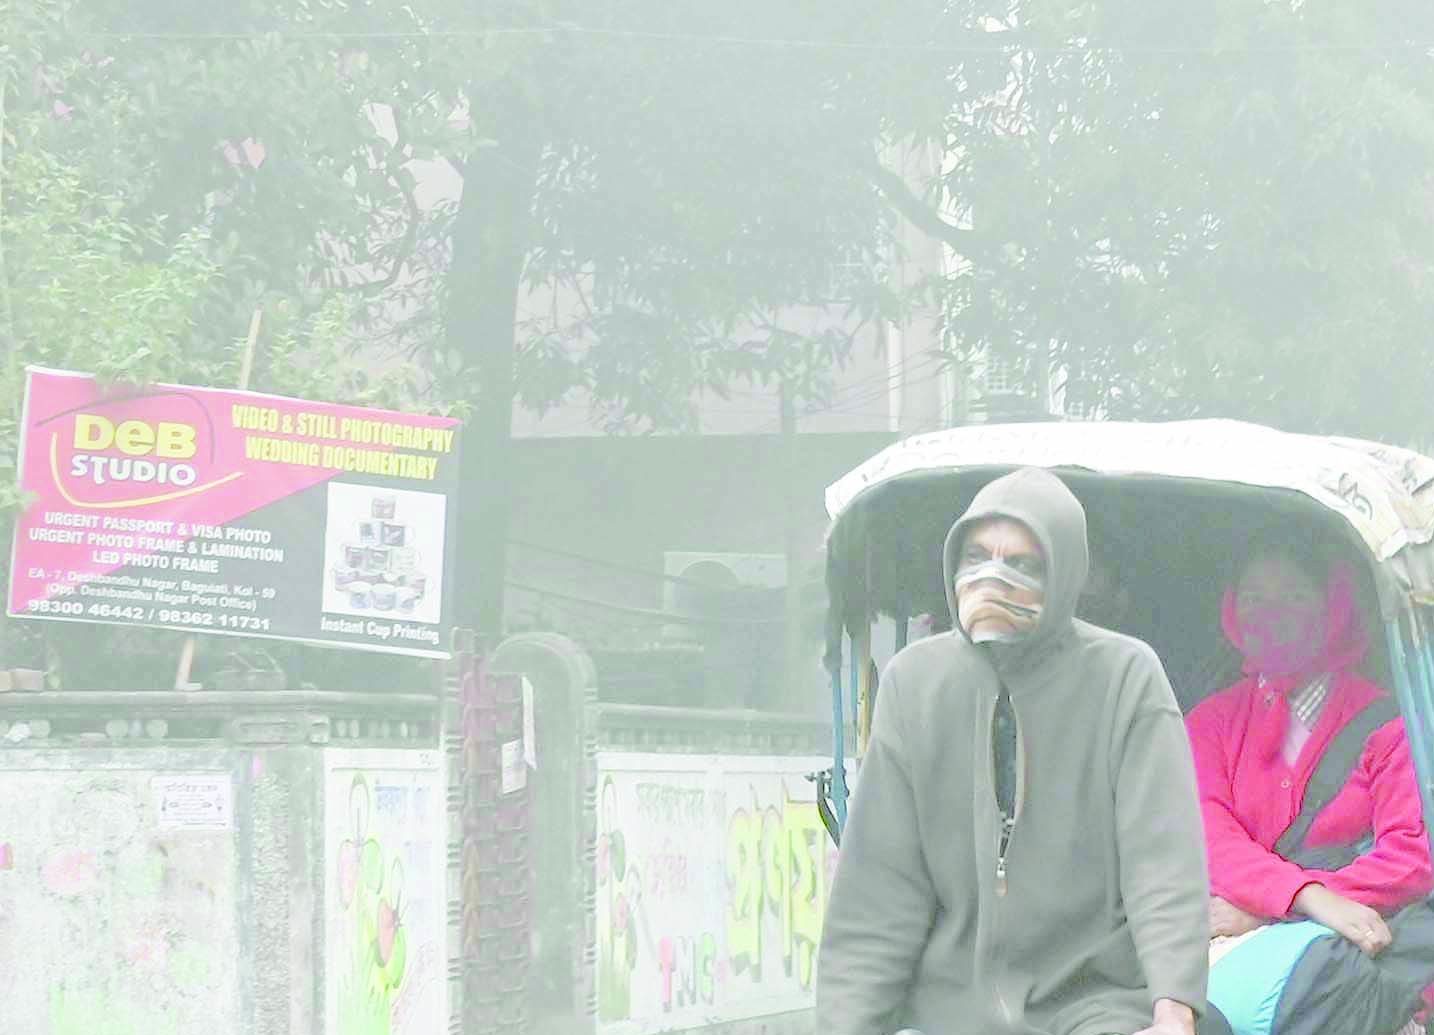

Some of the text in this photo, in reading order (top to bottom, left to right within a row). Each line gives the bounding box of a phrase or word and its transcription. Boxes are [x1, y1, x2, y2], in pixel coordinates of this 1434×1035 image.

[231, 403, 454, 453] VIDEO & STILL PHOTOGRAPHY
[70, 454, 198, 487] STUDIO
[245, 435, 438, 480] WEDDING DOCUMENTARY
[44, 511, 271, 545] URGENT PASSPORT & VISA PHOTO
[29, 527, 284, 564] URGENT PHOTO FRAME & LAMINATION
[123, 552, 169, 570] PHOTO
[172, 556, 219, 574] FRAME
[28, 599, 83, 616] 98300
[88, 604, 144, 621] 46442
[158, 608, 213, 626] 98362
[218, 613, 271, 631] 11731
[320, 616, 440, 646] Instant Cup Printing
